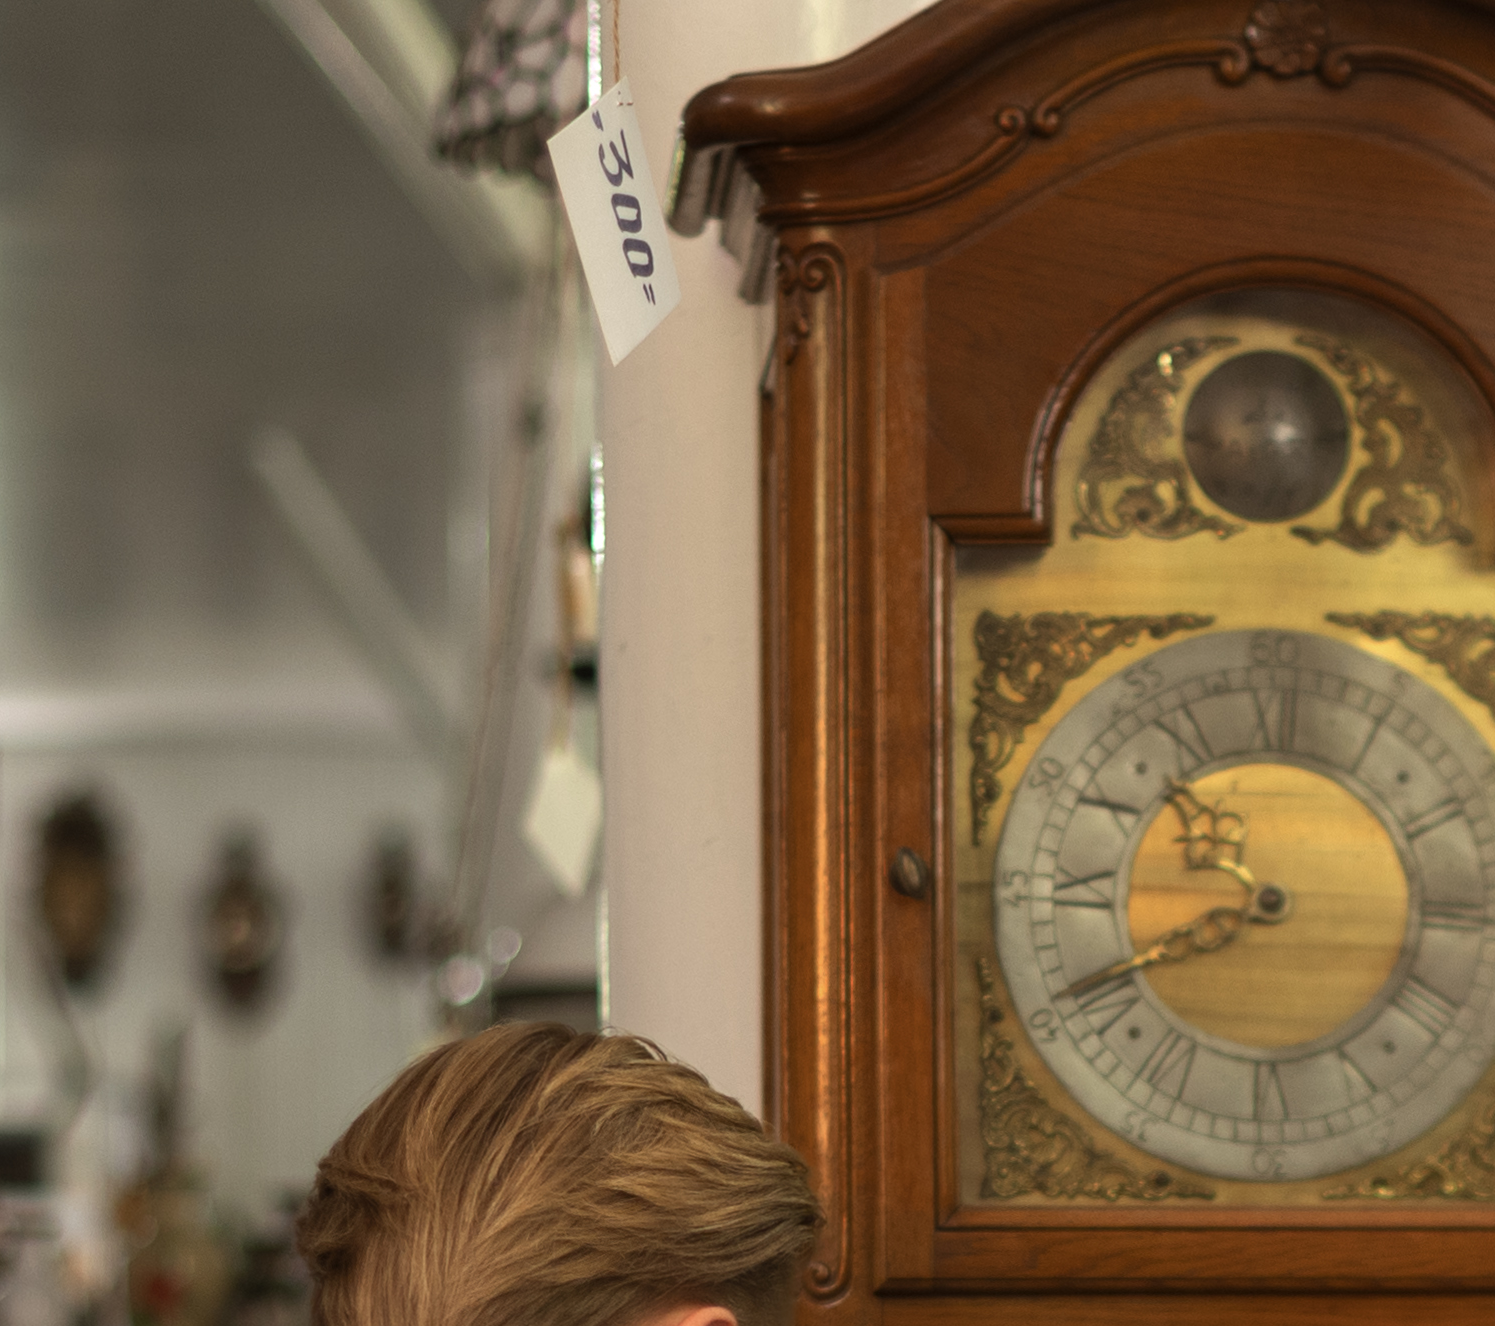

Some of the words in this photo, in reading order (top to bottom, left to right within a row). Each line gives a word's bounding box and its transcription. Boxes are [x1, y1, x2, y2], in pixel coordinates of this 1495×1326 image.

[1249, 631, 1298, 667] 60
[1249, 689, 1297, 752] XII
[1028, 757, 1065, 797] 50
[1003, 869, 1031, 907] 45
[1028, 1007, 1060, 1044] 40
